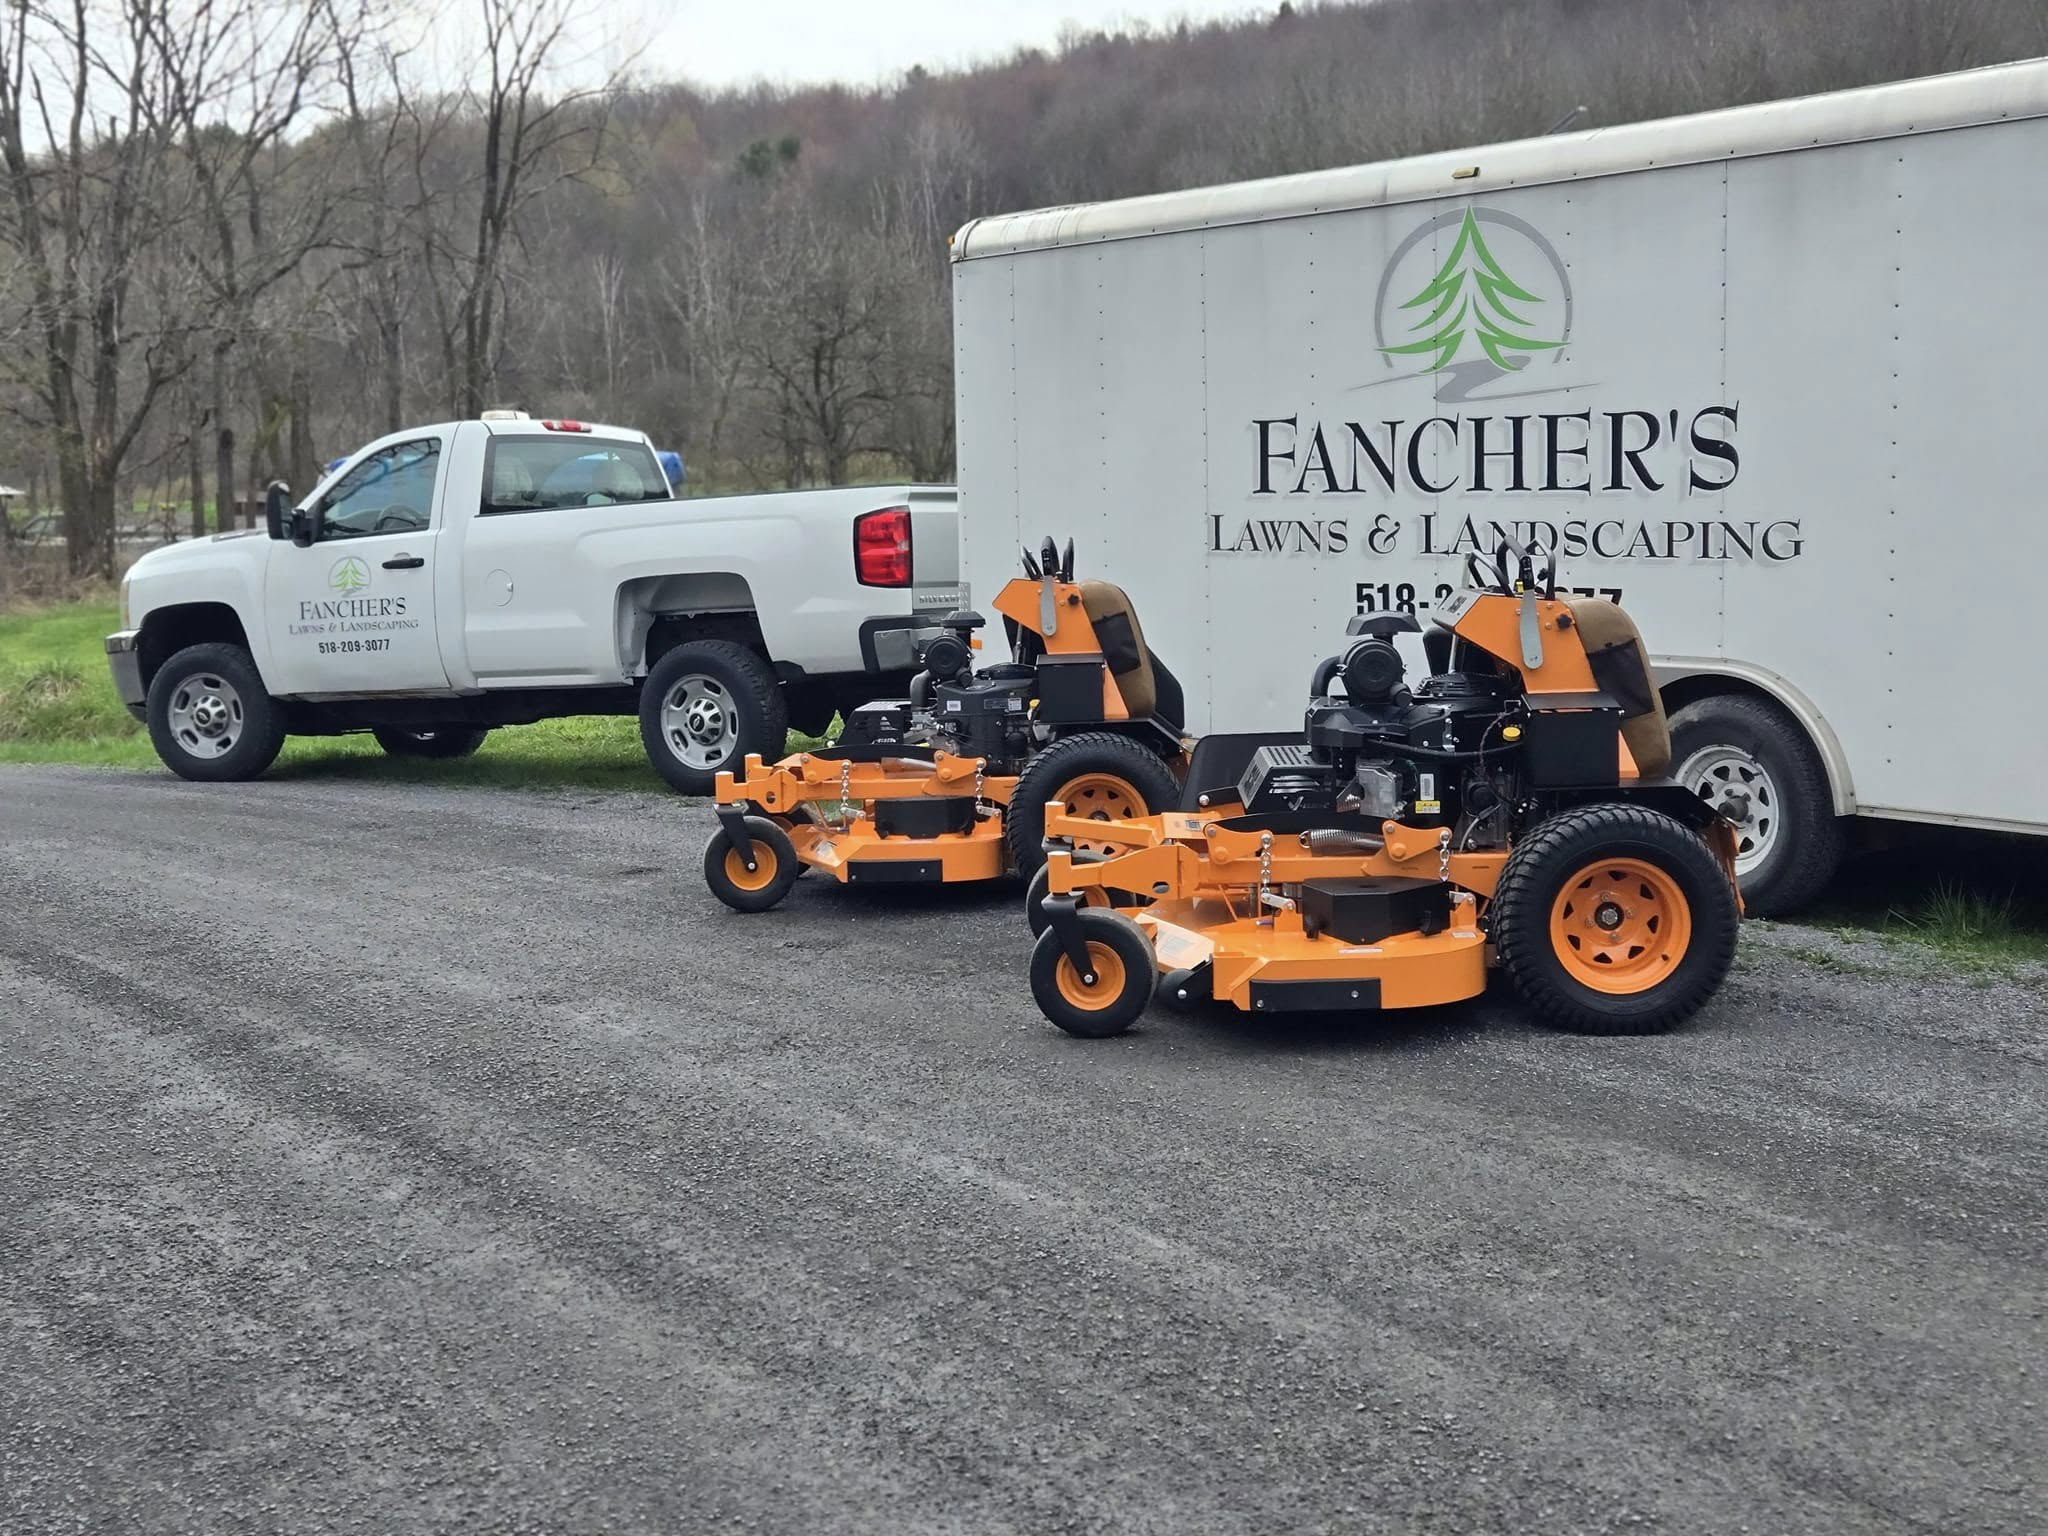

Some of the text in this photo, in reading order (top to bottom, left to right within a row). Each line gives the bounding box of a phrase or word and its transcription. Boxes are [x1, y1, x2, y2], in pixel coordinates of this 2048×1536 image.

[1252, 400, 1740, 497] FANCHER'S
[1210, 511, 1805, 561] LAWNS & LANDSCAPING
[300, 597, 407, 620] FANCHER'S
[289, 619, 419, 635] LAWNS & LANDSCAPING
[318, 639, 390, 653] 518-209-3077
